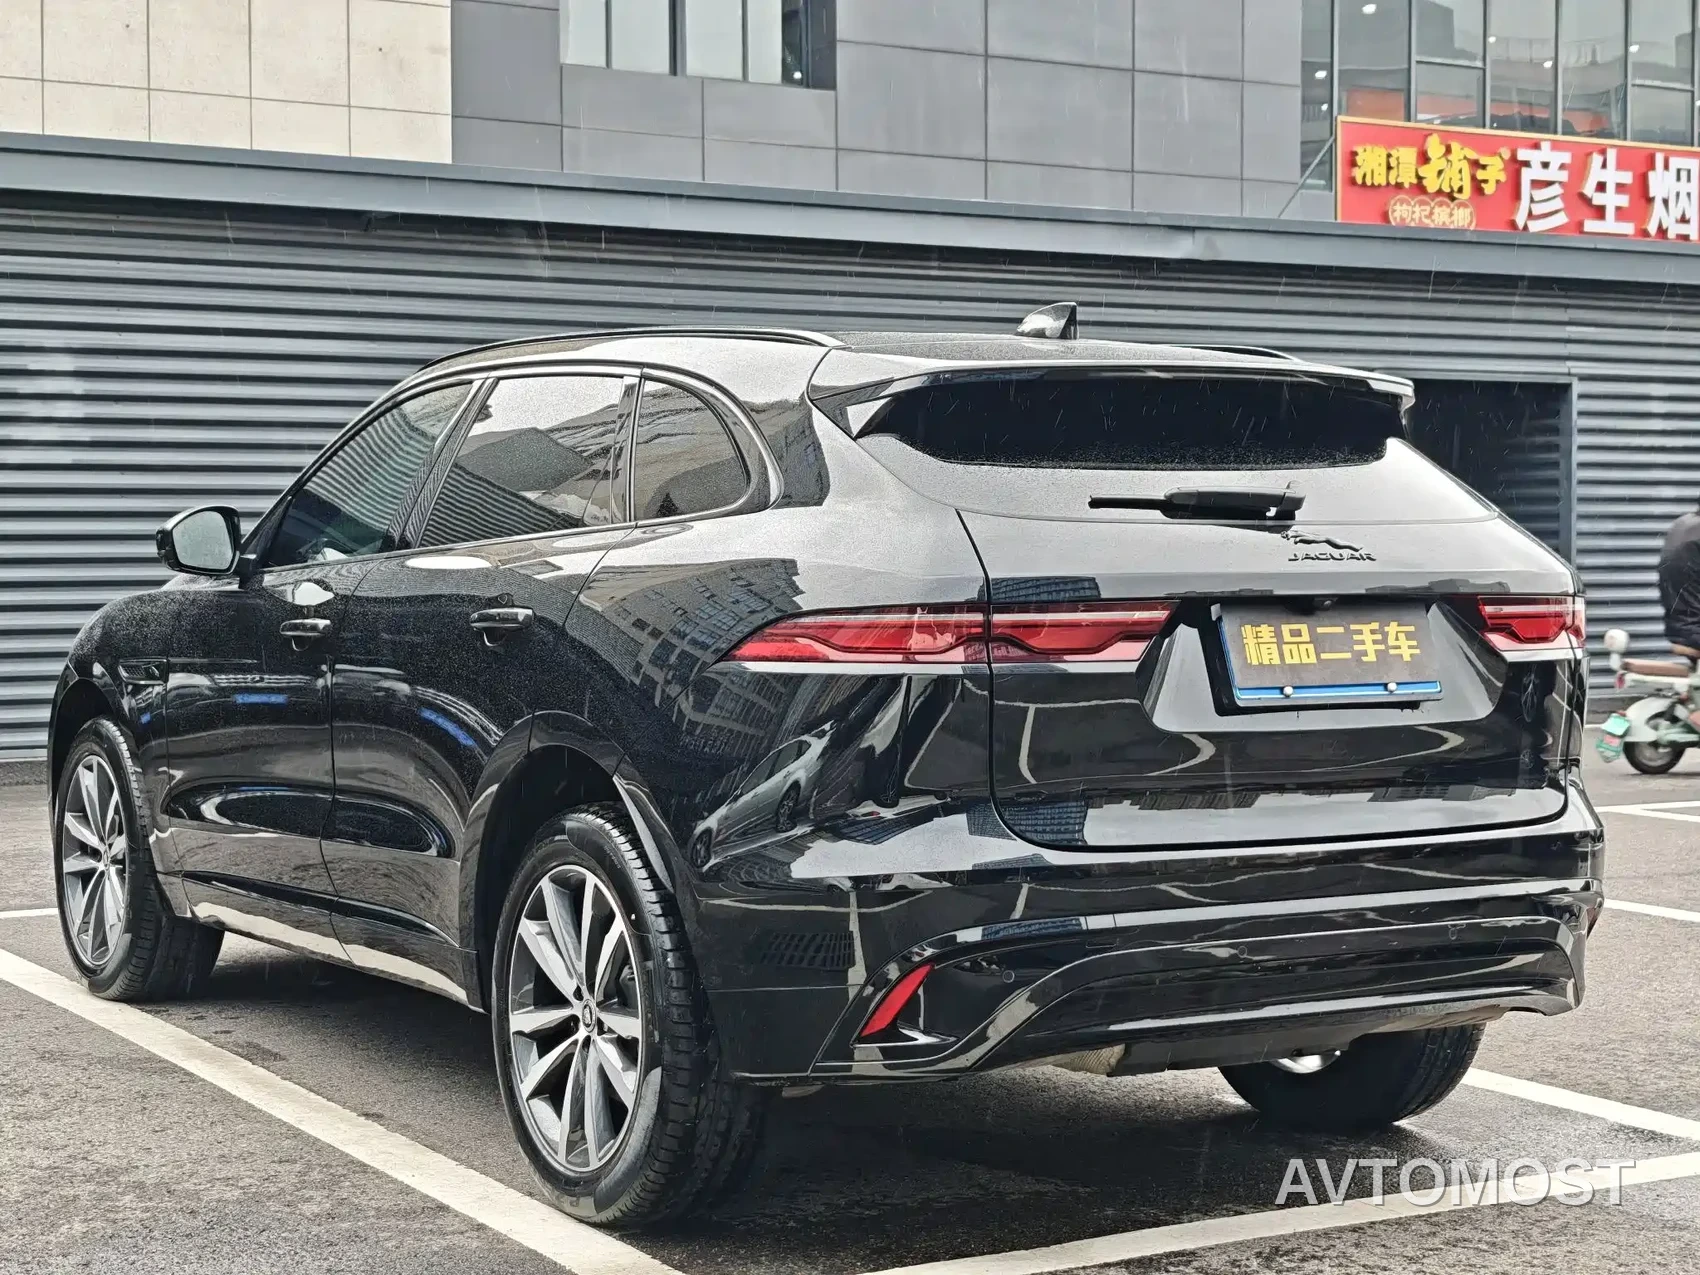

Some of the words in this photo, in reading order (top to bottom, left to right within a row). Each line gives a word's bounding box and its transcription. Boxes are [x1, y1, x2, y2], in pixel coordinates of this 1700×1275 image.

[1514, 142, 1699, 240] 彦生烟
[1288, 551, 1377, 562] JAGUAR
[1241, 622, 1421, 665] 精品二手车
